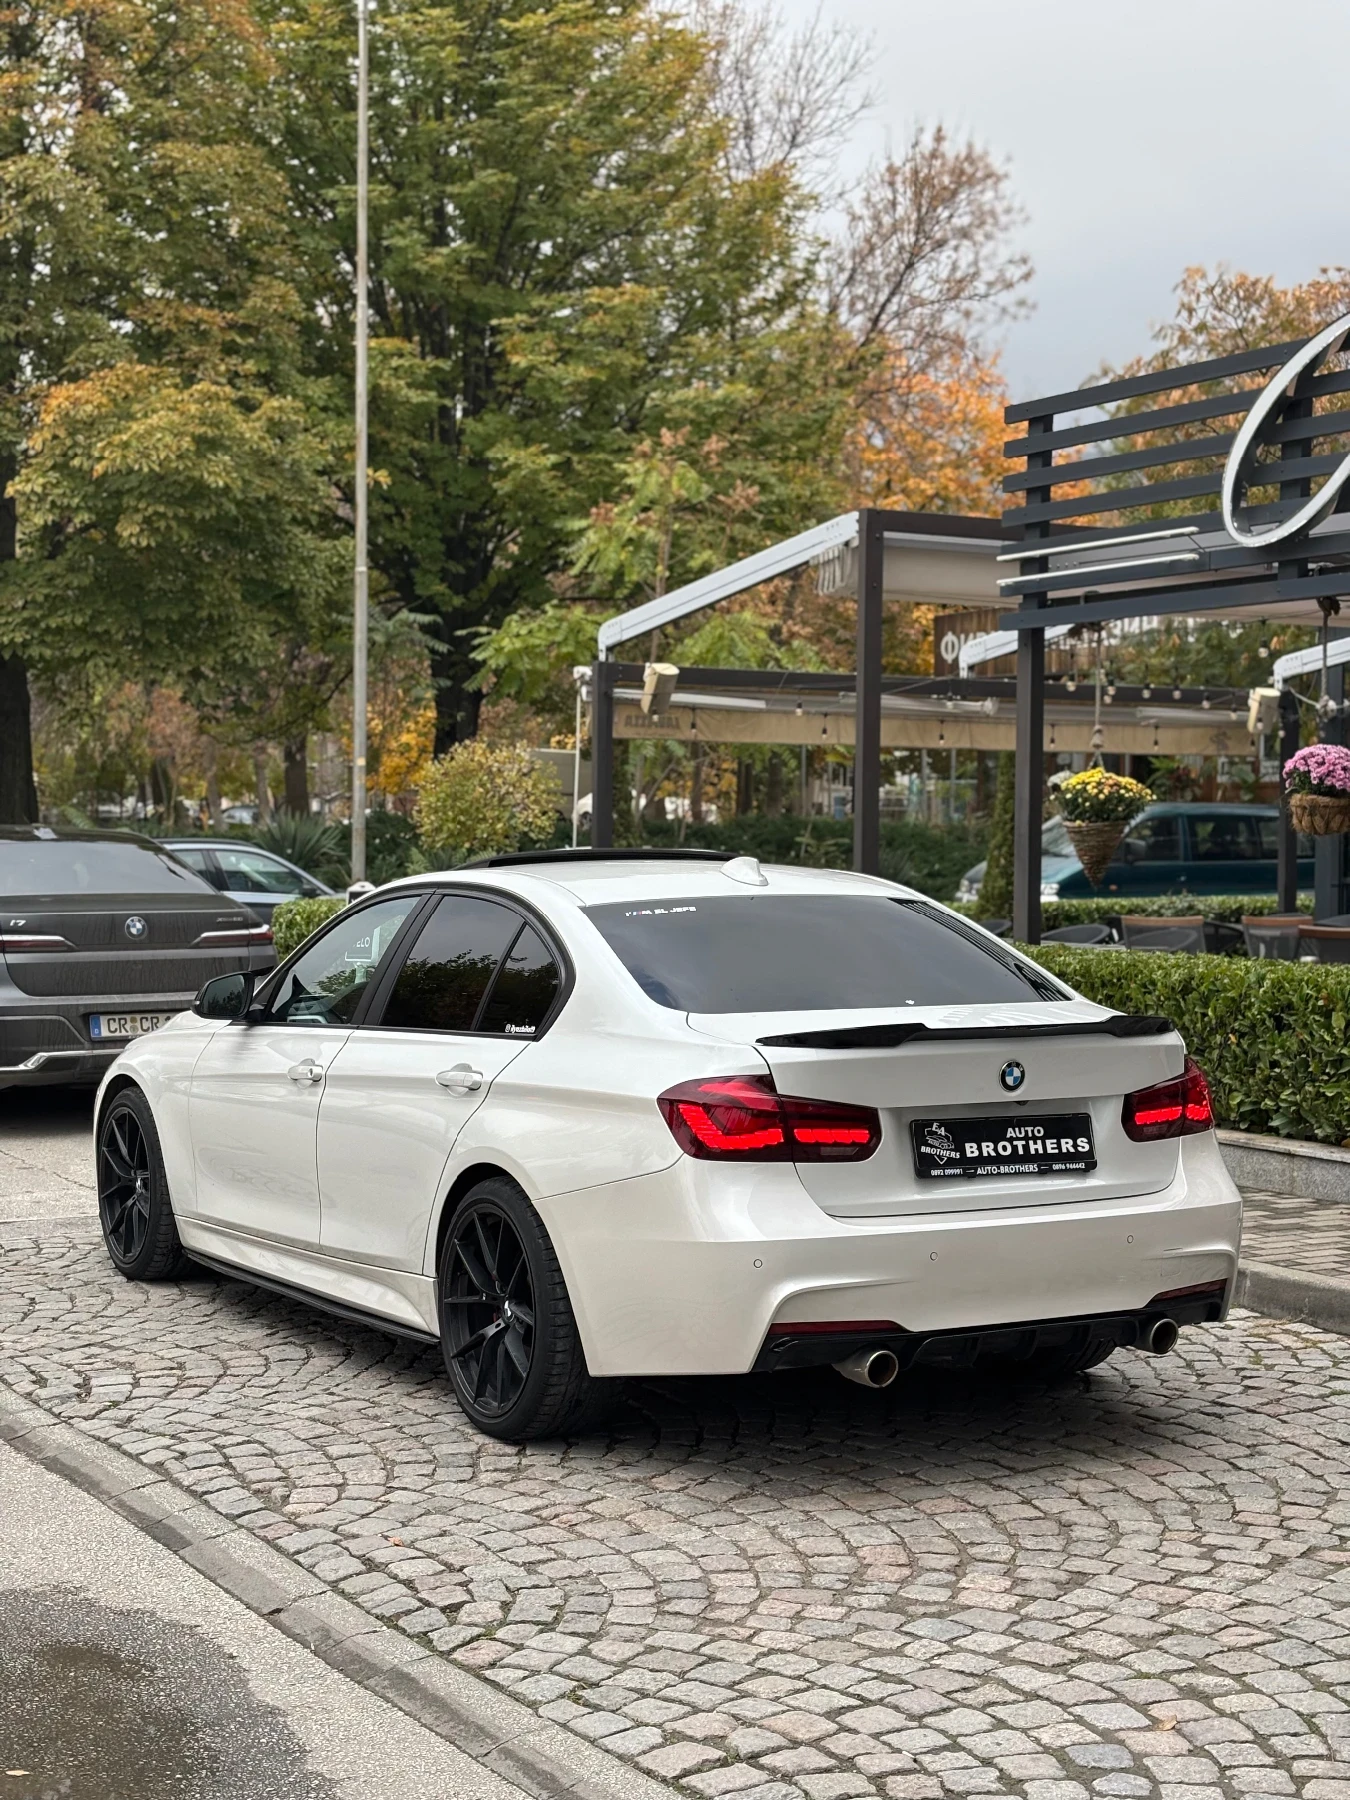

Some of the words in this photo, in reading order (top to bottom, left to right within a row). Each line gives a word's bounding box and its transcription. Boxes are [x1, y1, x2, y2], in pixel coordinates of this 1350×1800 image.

[106, 1017, 129, 1034] CR
[139, 1016, 160, 1033] CR
[931, 1122, 946, 1137] EA
[1005, 1126, 1045, 1139] AUTO
[920, 1145, 961, 1159] BROTHERS
[964, 1137, 1090, 1158] BROTHERS
[976, 1164, 1039, 1175] AUTO-BROTHERS
